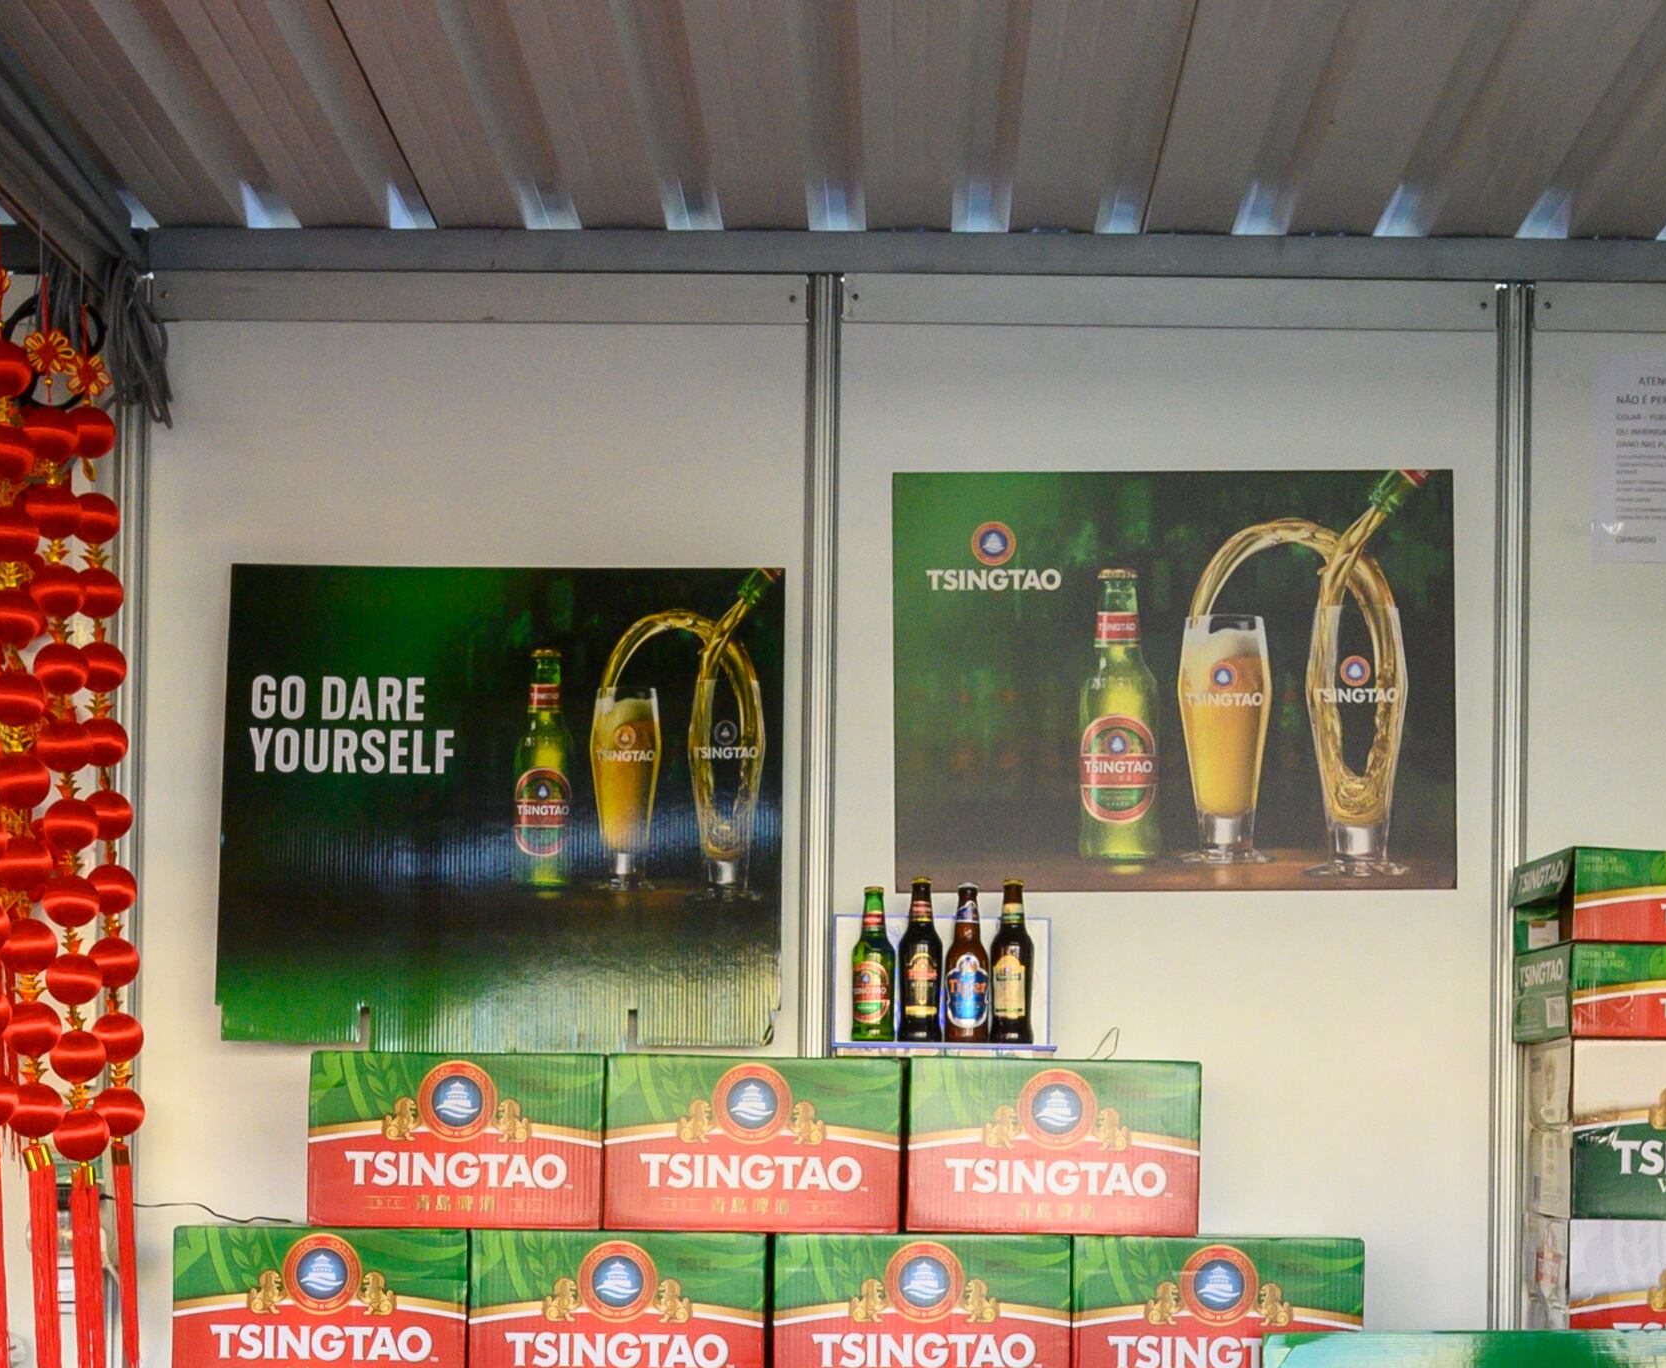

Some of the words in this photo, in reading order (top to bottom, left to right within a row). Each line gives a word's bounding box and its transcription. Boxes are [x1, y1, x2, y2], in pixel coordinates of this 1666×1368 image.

[926, 569, 1062, 592] TSINGTAO
[251, 674, 307, 721] GO
[321, 676, 426, 722] DARE
[1185, 692, 1264, 708] TSINGTAO
[1313, 687, 1399, 704] TSINGTAO
[249, 727, 455, 775] YOURSELF
[596, 749, 656, 763] TSINGTAO
[694, 746, 759, 760] TSINGTAO
[1084, 759, 1153, 775] TSINGTAO
[516, 803, 570, 817] TSINGTAO
[949, 978, 989, 995] Tiger
[345, 1151, 569, 1189] TSINGTAO
[639, 1152, 863, 1193] TSINGTAO
[209, 1323, 434, 1363] TSINGTAO
